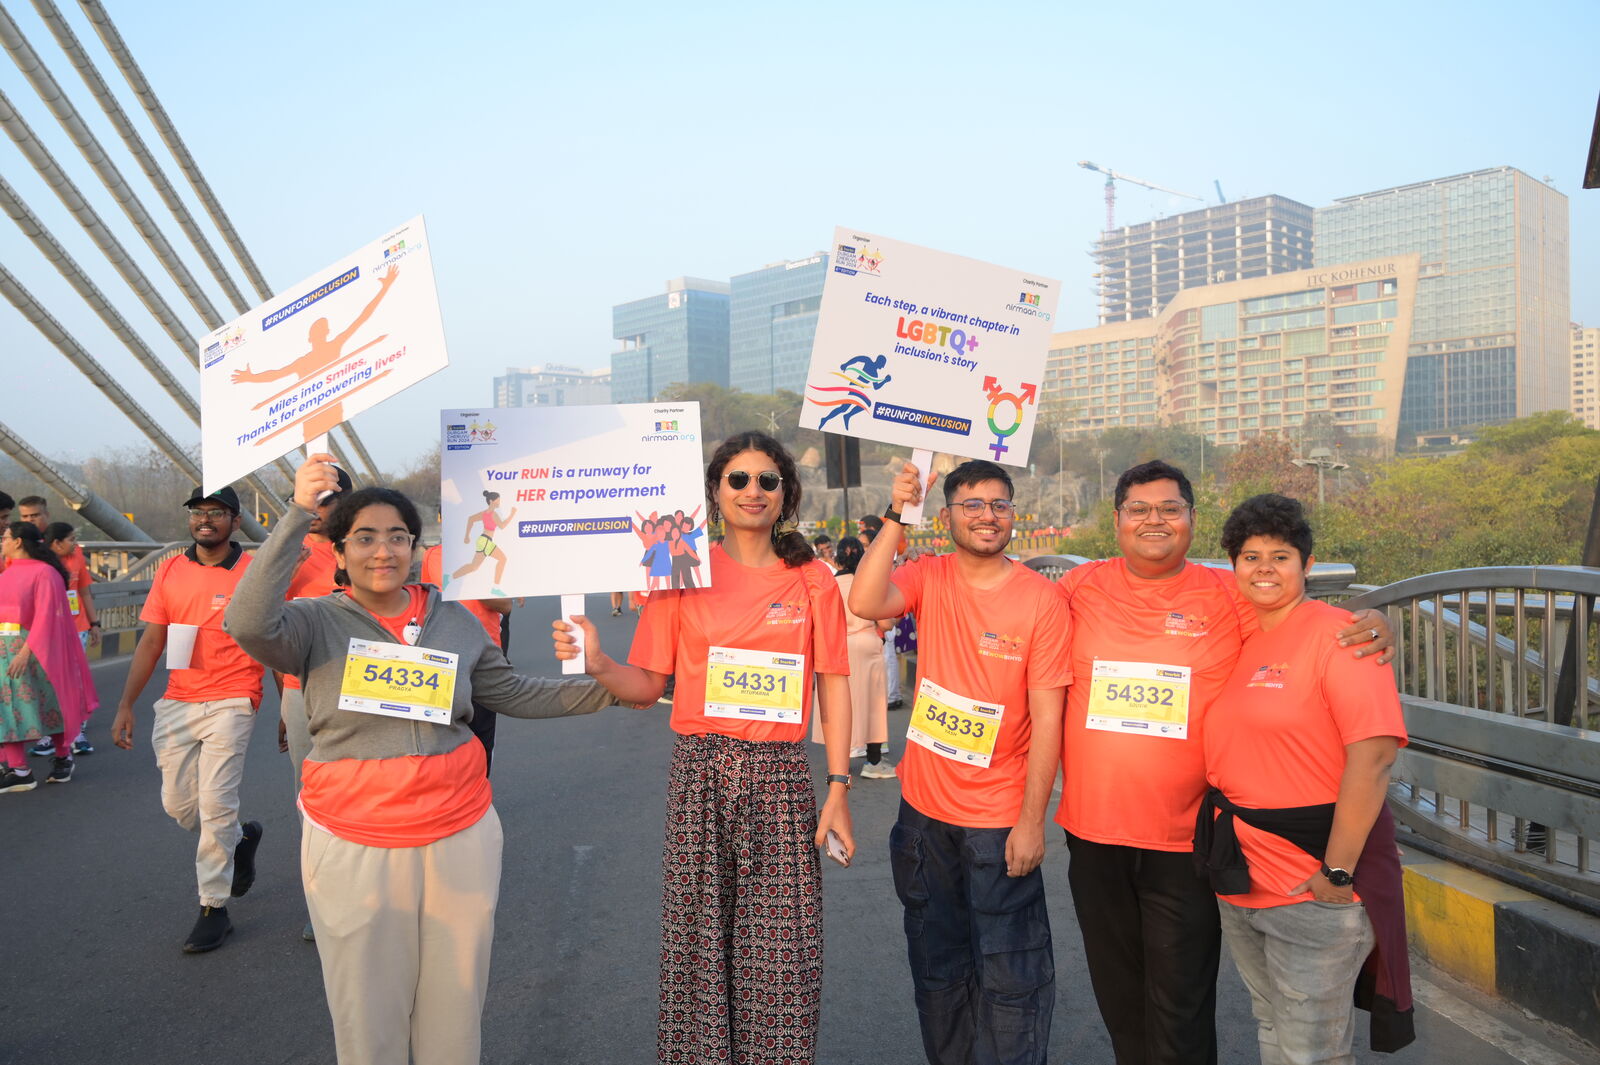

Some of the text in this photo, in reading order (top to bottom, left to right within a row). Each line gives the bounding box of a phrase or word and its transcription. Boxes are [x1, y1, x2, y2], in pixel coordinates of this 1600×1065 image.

[1307, 264, 1396, 287] ITC KOHENUR
[264, 270, 358, 328] #RUNFORINCLUSION
[865, 292, 892, 308] Each
[894, 300, 918, 316] step,
[930, 308, 968, 324] vibrant
[969, 316, 1009, 334] chapter
[1010, 325, 1020, 336] in
[896, 317, 979, 355] LGBTQ+
[894, 343, 978, 372] inclusion's story
[236, 346, 406, 446] Thanks for empowering lives!
[269, 394, 298, 416] Miles
[301, 380, 323, 399] into
[876, 405, 969, 432] #RUNFORINCLUSION
[486, 464, 651, 481] Your RUN is a runway for
[516, 483, 666, 503] HER empowerment
[521, 520, 630, 534] #RUNFORINCLUSION
[363, 664, 439, 690] 54334
[723, 670, 786, 693] 54331
[1106, 684, 1174, 706] 54332
[926, 704, 985, 738] 54333
